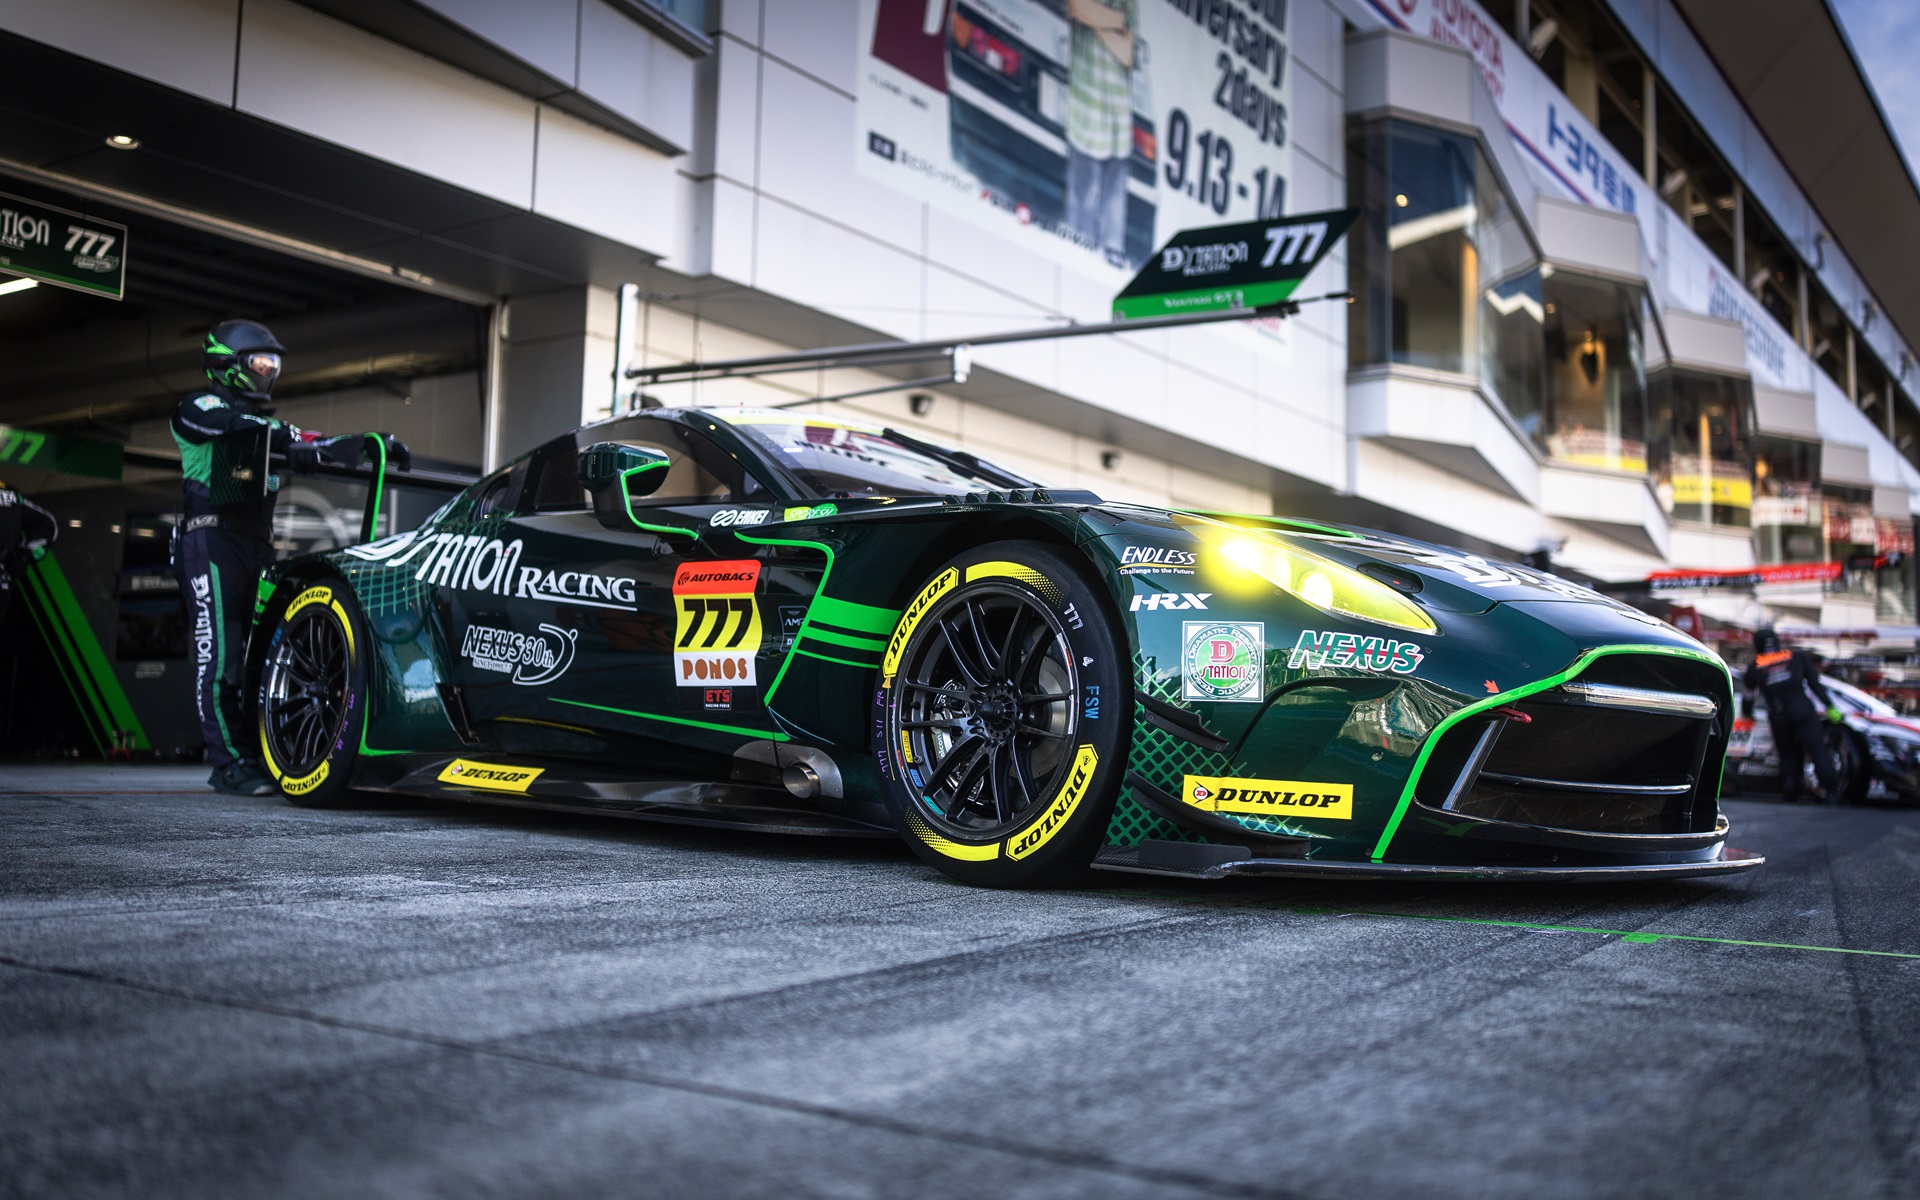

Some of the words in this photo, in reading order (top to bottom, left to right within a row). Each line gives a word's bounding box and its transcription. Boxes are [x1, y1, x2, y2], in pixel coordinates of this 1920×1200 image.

[1214, 50, 1288, 148] 2days
[1154, 108, 1233, 215] 9.13
[1254, 165, 1287, 221] 14
[64, 224, 117, 258] 777
[1259, 220, 1329, 268] 777
[1121, 546, 1198, 565] ENDLESS
[515, 565, 637, 611] RACING
[689, 572, 755, 583] AUTOBACS
[890, 573, 953, 659] DUNLOP
[1129, 592, 1213, 612] HRX
[677, 598, 754, 648] 777
[461, 624, 525, 663] NEXUS
[522, 635, 555, 668] 30th
[1189, 627, 1228, 659] DRAMATIC
[1231, 628, 1258, 662] RESORT
[1288, 630, 1424, 673] NEXUS
[682, 657, 748, 680] PONOS
[1200, 665, 1246, 679] STATION
[1218, 664, 1258, 696] DRAMATIC
[705, 689, 731, 703] ETS
[1085, 685, 1100, 719] FSW
[462, 767, 530, 783] DUNLOP
[1013, 765, 1087, 856] DUNLOP
[1215, 787, 1341, 808] DUNLOP
